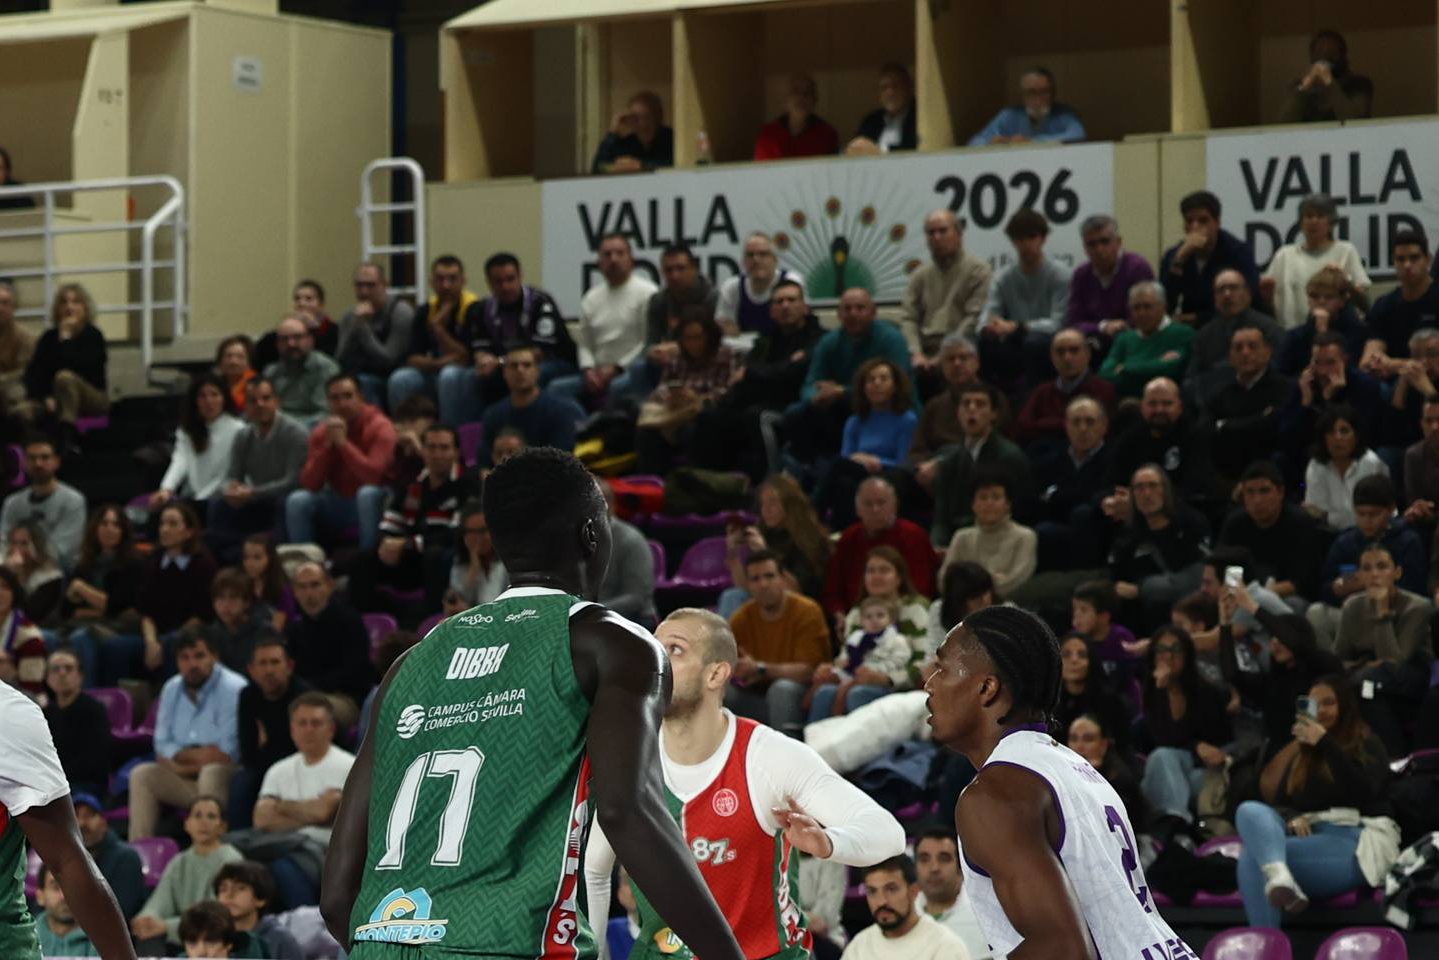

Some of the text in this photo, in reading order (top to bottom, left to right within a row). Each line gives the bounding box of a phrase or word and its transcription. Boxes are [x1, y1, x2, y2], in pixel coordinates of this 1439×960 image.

[934, 168, 1080, 230] 2026
[1240, 148, 1423, 212] VALLA
[577, 194, 739, 251] VALLA
[445, 643, 510, 680] DIBBA
[424, 702, 524, 732] COMERCIO SEVILLA
[428, 699, 476, 718] CAMPUS
[374, 745, 485, 871] 17
